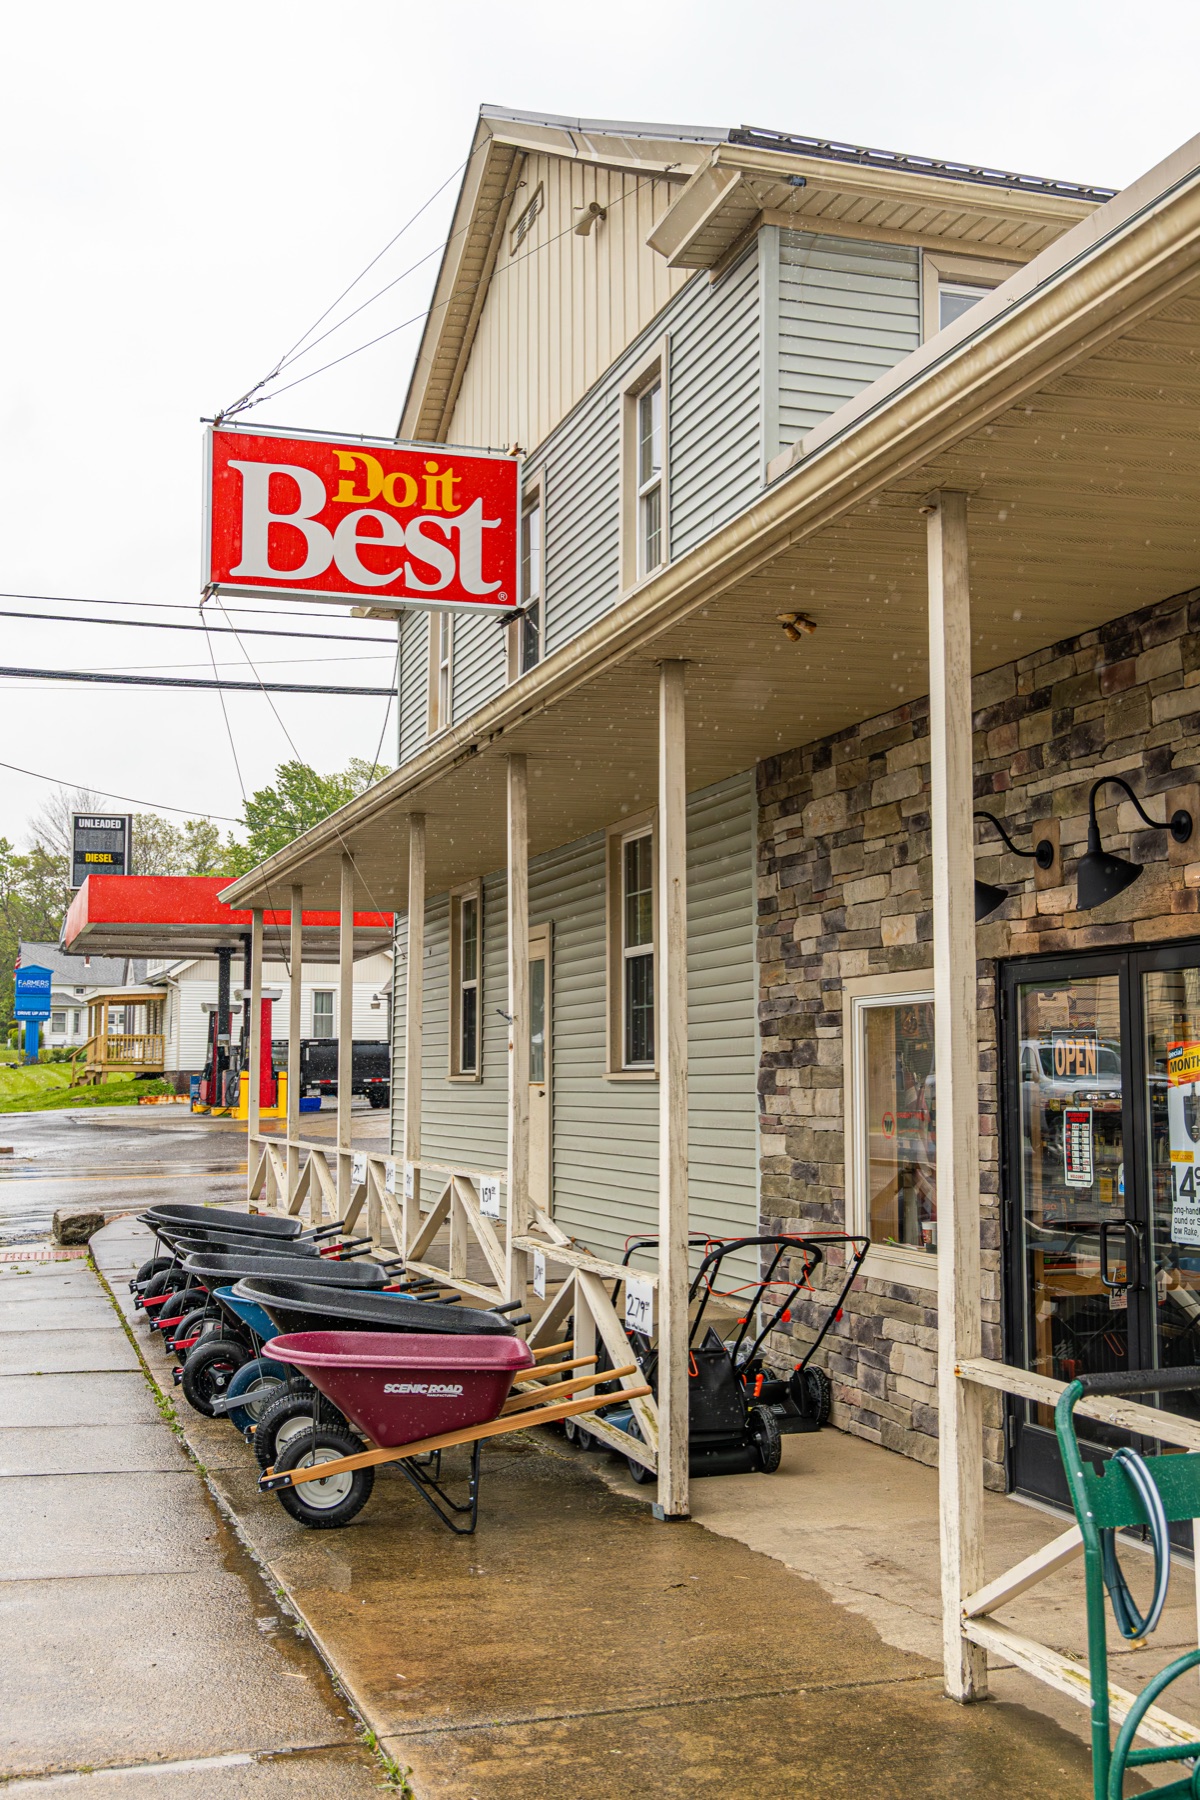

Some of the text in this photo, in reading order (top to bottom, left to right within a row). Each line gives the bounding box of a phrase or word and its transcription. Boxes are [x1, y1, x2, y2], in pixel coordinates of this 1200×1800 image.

[332, 449, 462, 512] Do it
[227, 459, 502, 595] Best
[78, 818, 121, 829] UNLEADED
[85, 853, 113, 863] DIESEL
[1055, 1038, 1096, 1076] OPEN
[383, 1383, 464, 1394] SCENIC ROAD
